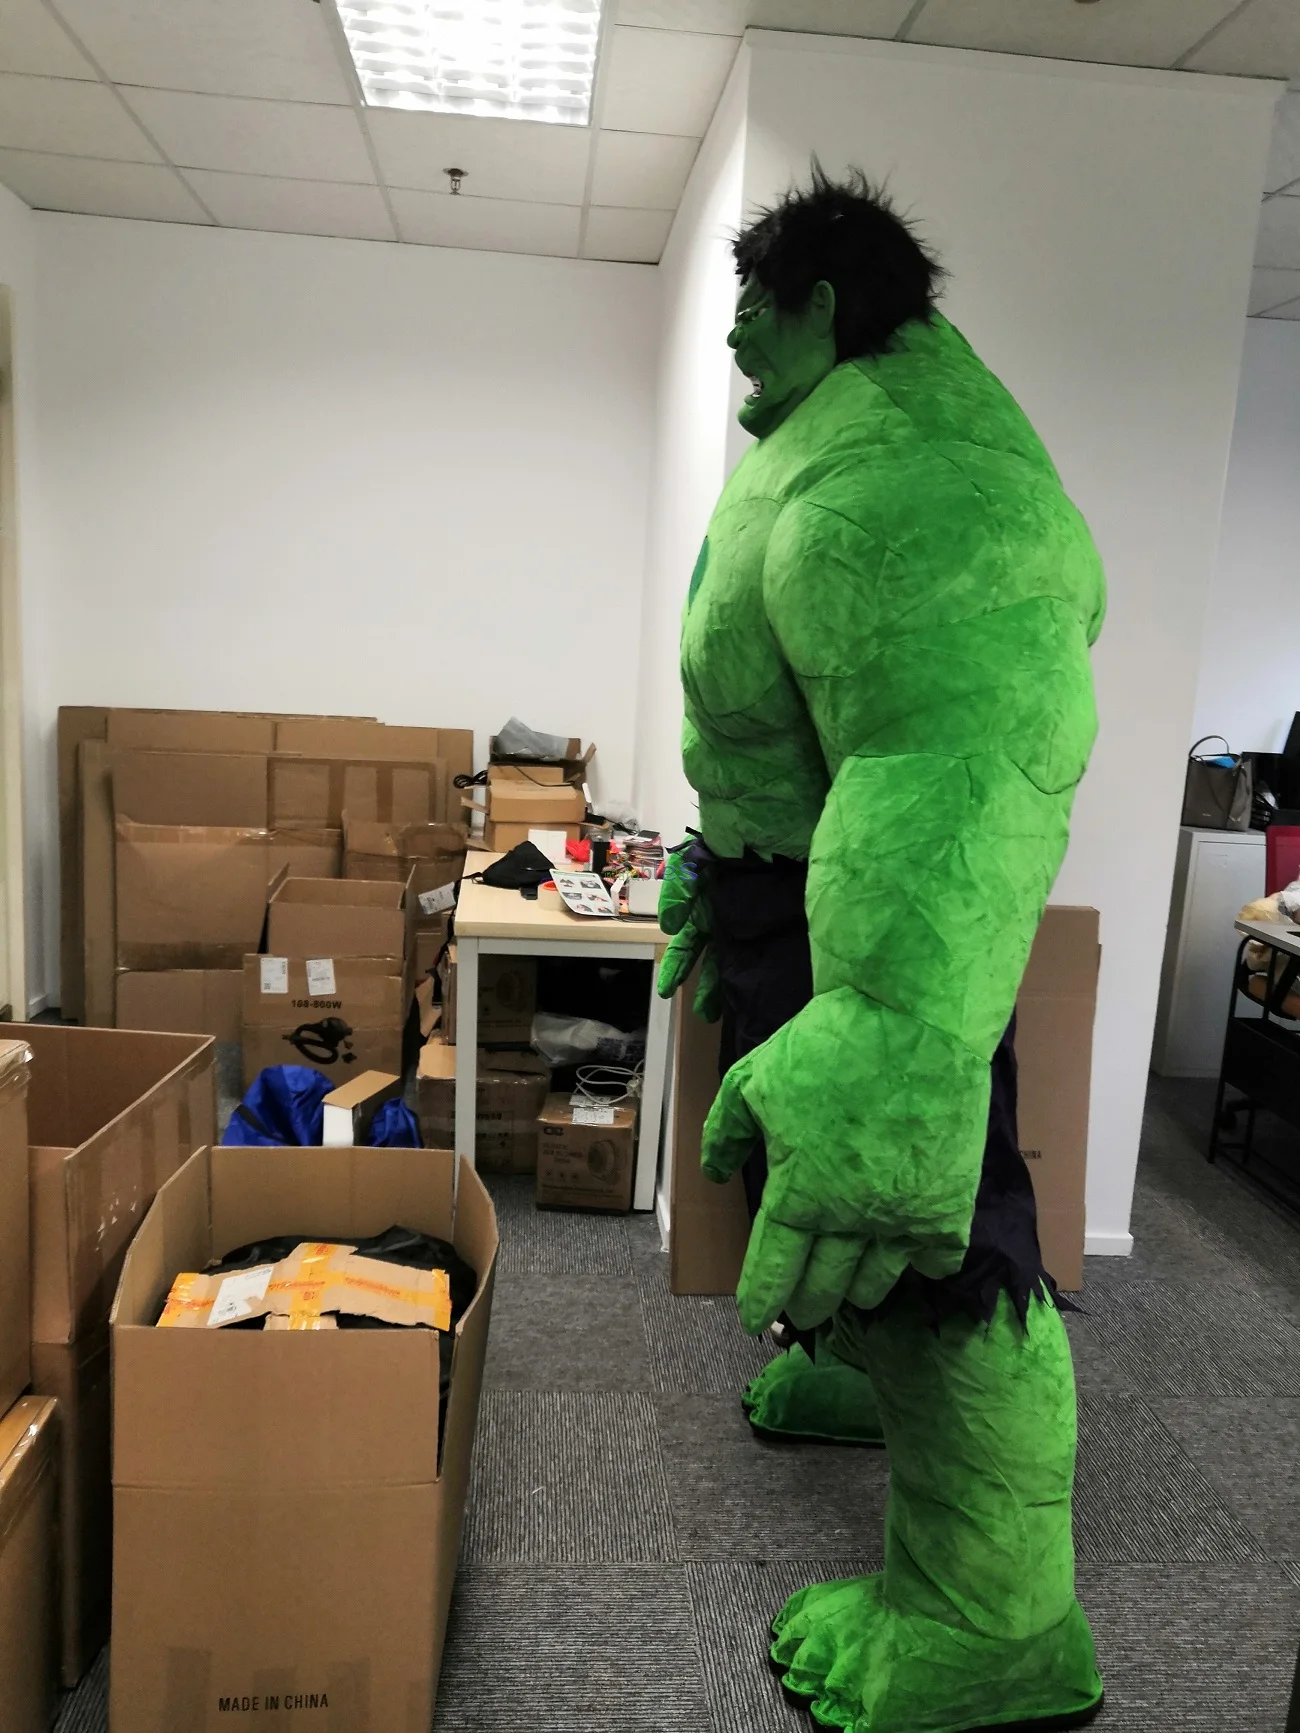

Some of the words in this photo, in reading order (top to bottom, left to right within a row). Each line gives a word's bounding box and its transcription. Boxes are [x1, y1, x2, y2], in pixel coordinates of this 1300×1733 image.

[218, 1696, 260, 1711] MADE
[264, 1695, 280, 1710] IN
[284, 1693, 329, 1710] CHINA
